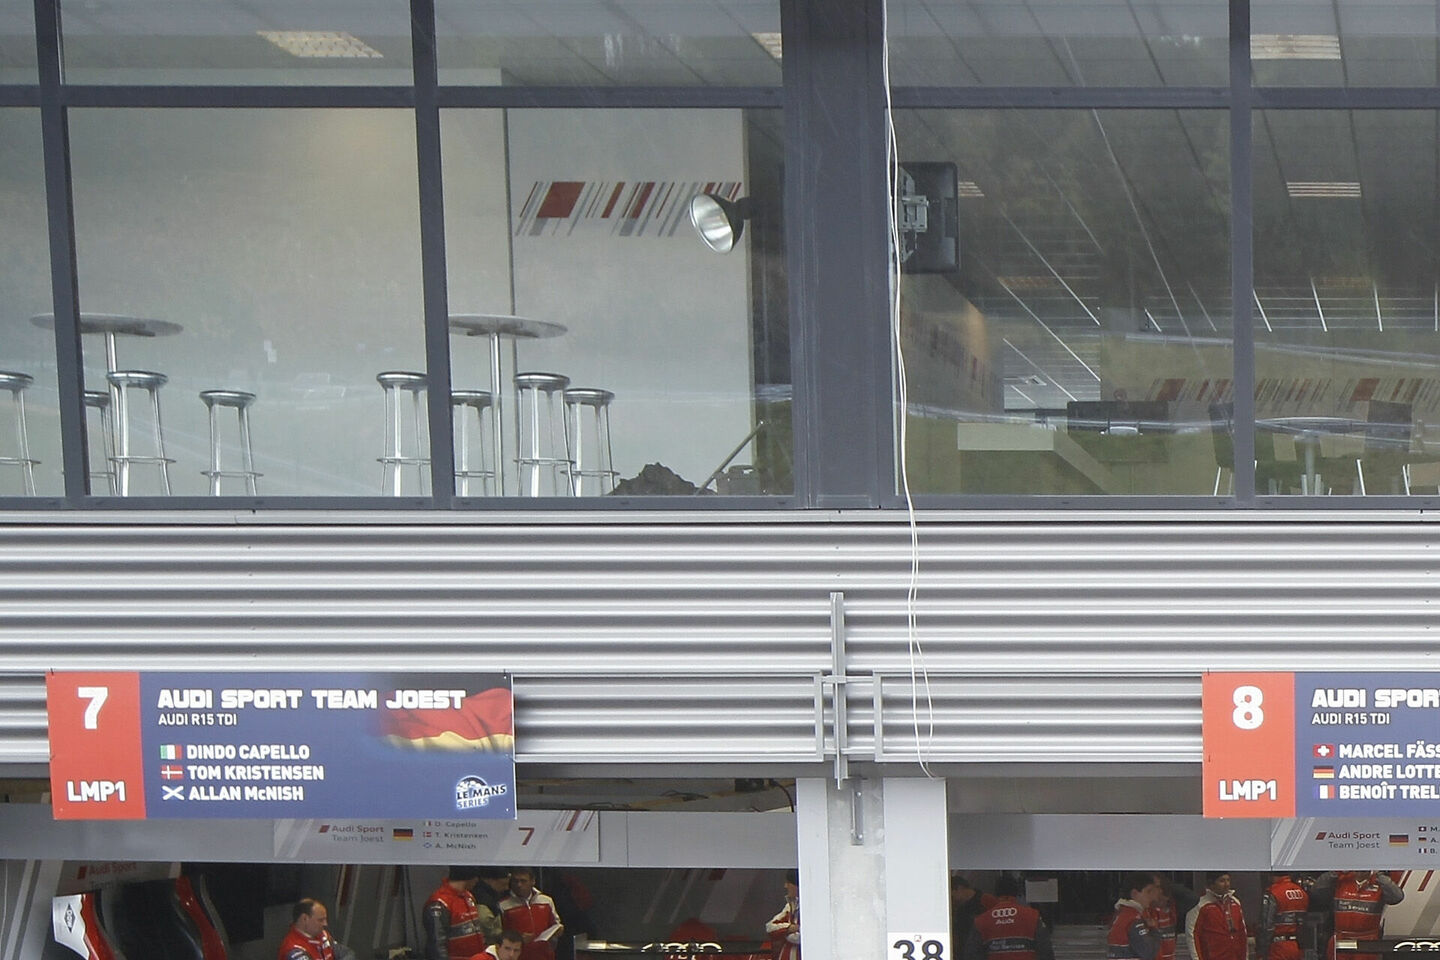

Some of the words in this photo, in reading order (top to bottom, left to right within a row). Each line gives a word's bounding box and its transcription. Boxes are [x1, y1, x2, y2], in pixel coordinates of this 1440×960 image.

[158, 690, 212, 708] AUDI
[221, 690, 302, 709] SPORT
[312, 690, 377, 709] TEAM
[385, 690, 466, 709] JOEST
[1312, 689, 1366, 708] AUDI
[78, 687, 108, 729] 7
[1233, 686, 1264, 730] 8
[158, 714, 188, 725] AUDI
[192, 714, 214, 725] R15
[217, 714, 237, 725] TDI
[1312, 713, 1341, 725] AUDI
[1345, 713, 1367, 725] R15
[1370, 713, 1390, 725] TDI
[187, 745, 236, 760] DINDO
[239, 745, 310, 760] CAPELLO
[1339, 744, 1403, 758] MARCEL
[188, 765, 221, 780] TOM
[225, 765, 324, 780] KRISTENSEN
[1339, 765, 1393, 779] ANDRE
[67, 781, 126, 801] LMP1
[189, 786, 241, 801] ALLAN
[245, 786, 304, 801] McNISH
[457, 790, 469, 800] LE
[473, 784, 506, 798] MANS
[1219, 780, 1277, 800] LMP1
[1339, 781, 1396, 799] BENOÎT
[457, 798, 489, 808] SERIES
[332, 825, 354, 833] Audi
[357, 825, 384, 834] Sport
[518, 827, 535, 845] 7
[1353, 832, 1380, 841] Sport
[360, 835, 384, 843] Joest
[1356, 842, 1380, 850] Joest
